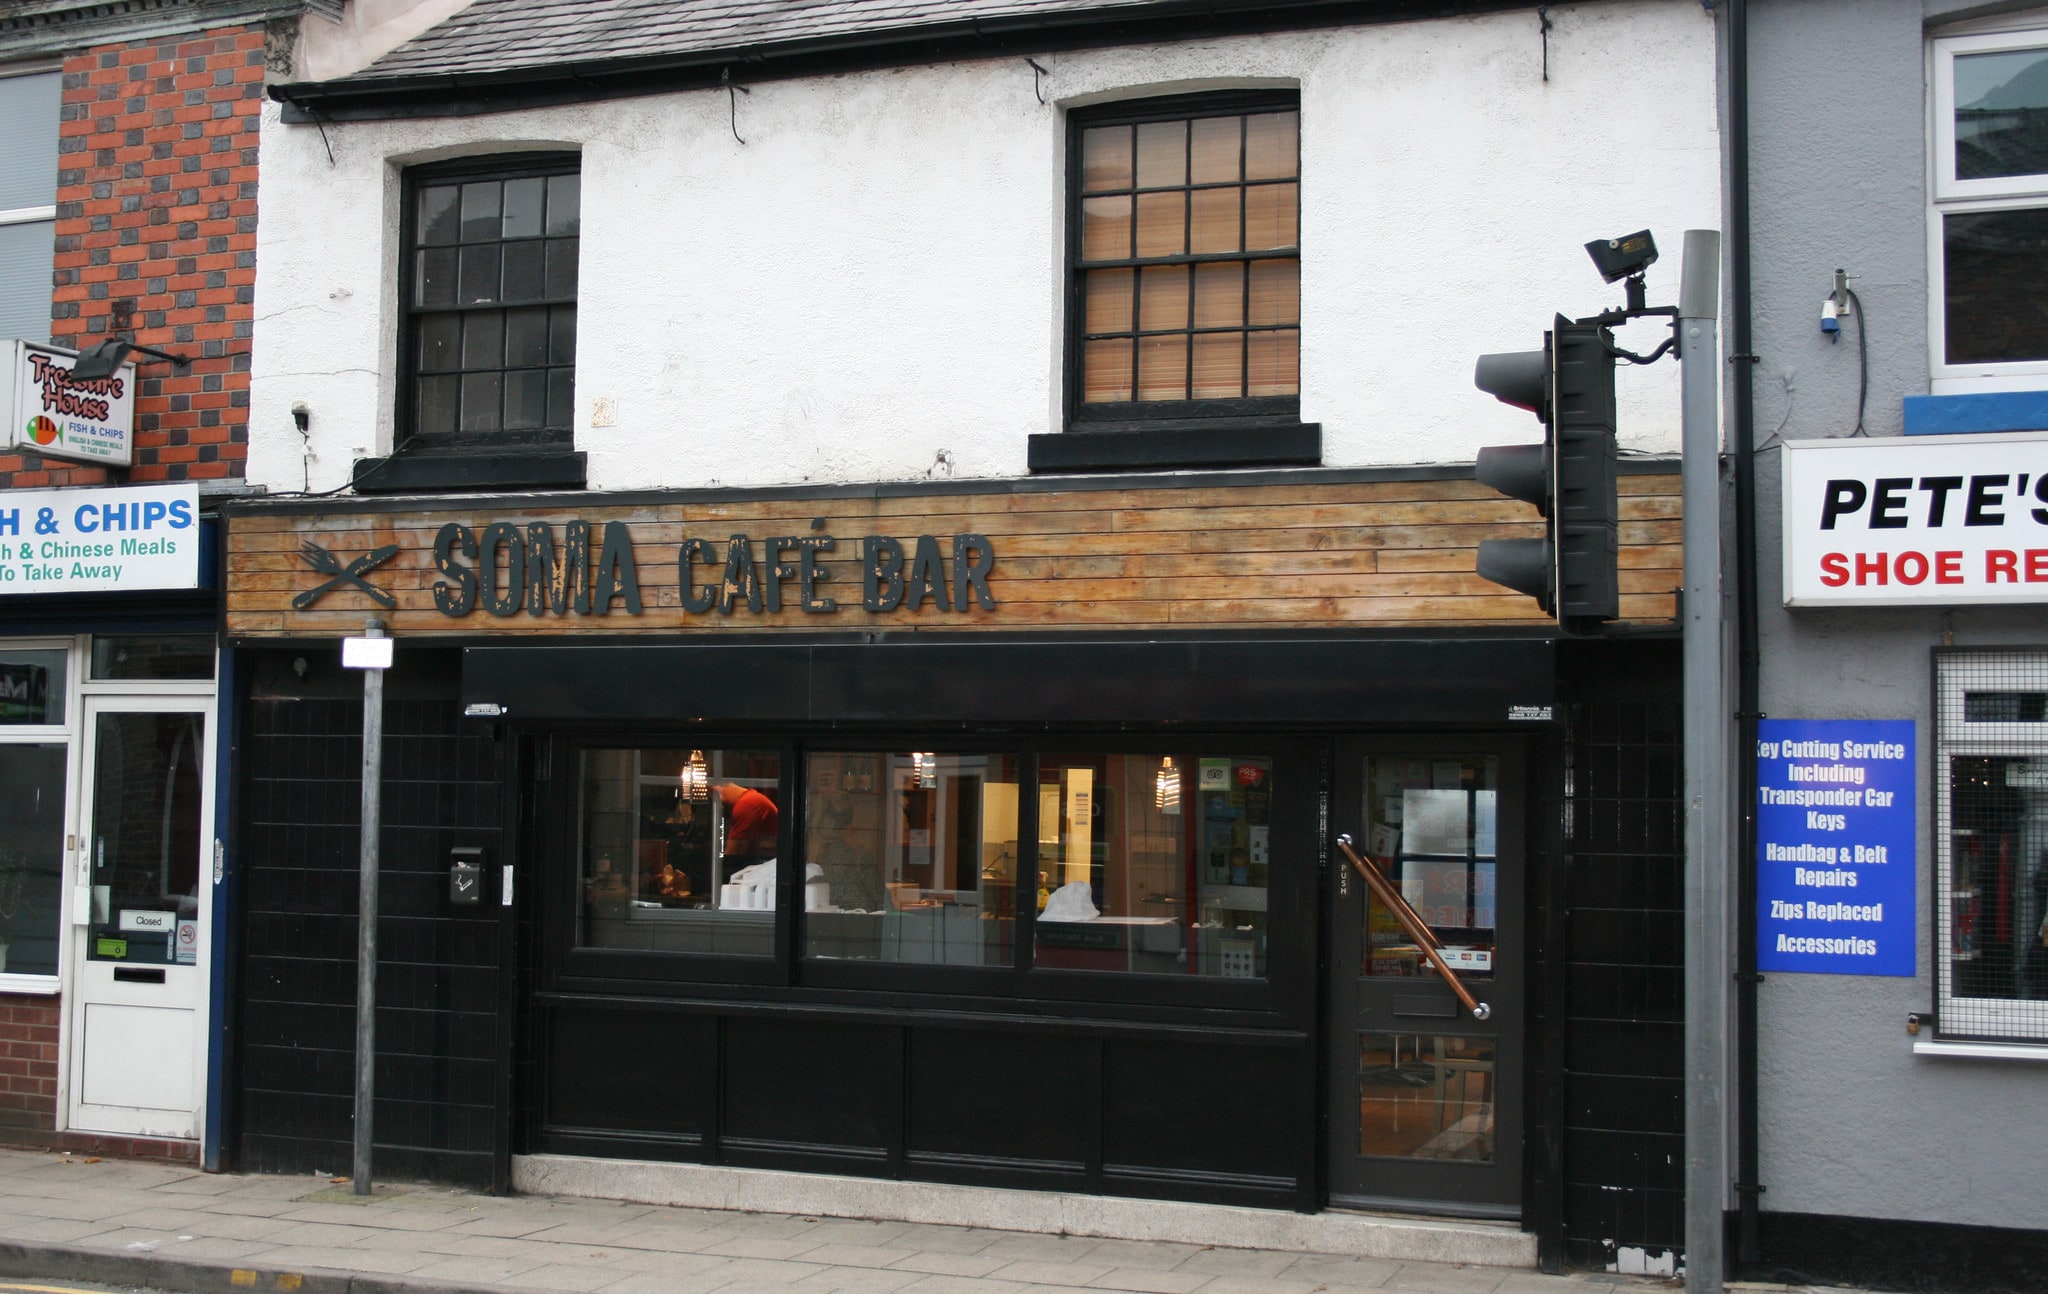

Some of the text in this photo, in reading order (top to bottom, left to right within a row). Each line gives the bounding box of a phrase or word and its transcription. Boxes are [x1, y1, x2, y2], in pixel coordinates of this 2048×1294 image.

[42, 382, 109, 421] House
[69, 422, 124, 440] FISH & CHIPS
[34, 507, 60, 535] &
[74, 500, 192, 534] CHIPS
[19, 542, 34, 560] &
[41, 540, 114, 558] Chinese
[120, 537, 176, 556] Meals
[0, 561, 122, 582] To Take Away
[434, 517, 995, 618] SOMA CAFÉ BAR
[1819, 549, 2048, 587] SHOE RE
[1782, 740, 1839, 760] Cutting
[1843, 740, 1904, 759] Service
[1788, 764, 1865, 784] Including
[1760, 786, 1894, 808] Transponder Car
[1806, 811, 1846, 831] Keys
[1766, 843, 1888, 865] Handbag & Belt
[1795, 867, 1857, 888] Repairs
[136, 915, 162, 926] Closed
[1771, 900, 1883, 922] Zips Replaced
[1776, 934, 1877, 955] Accessories
